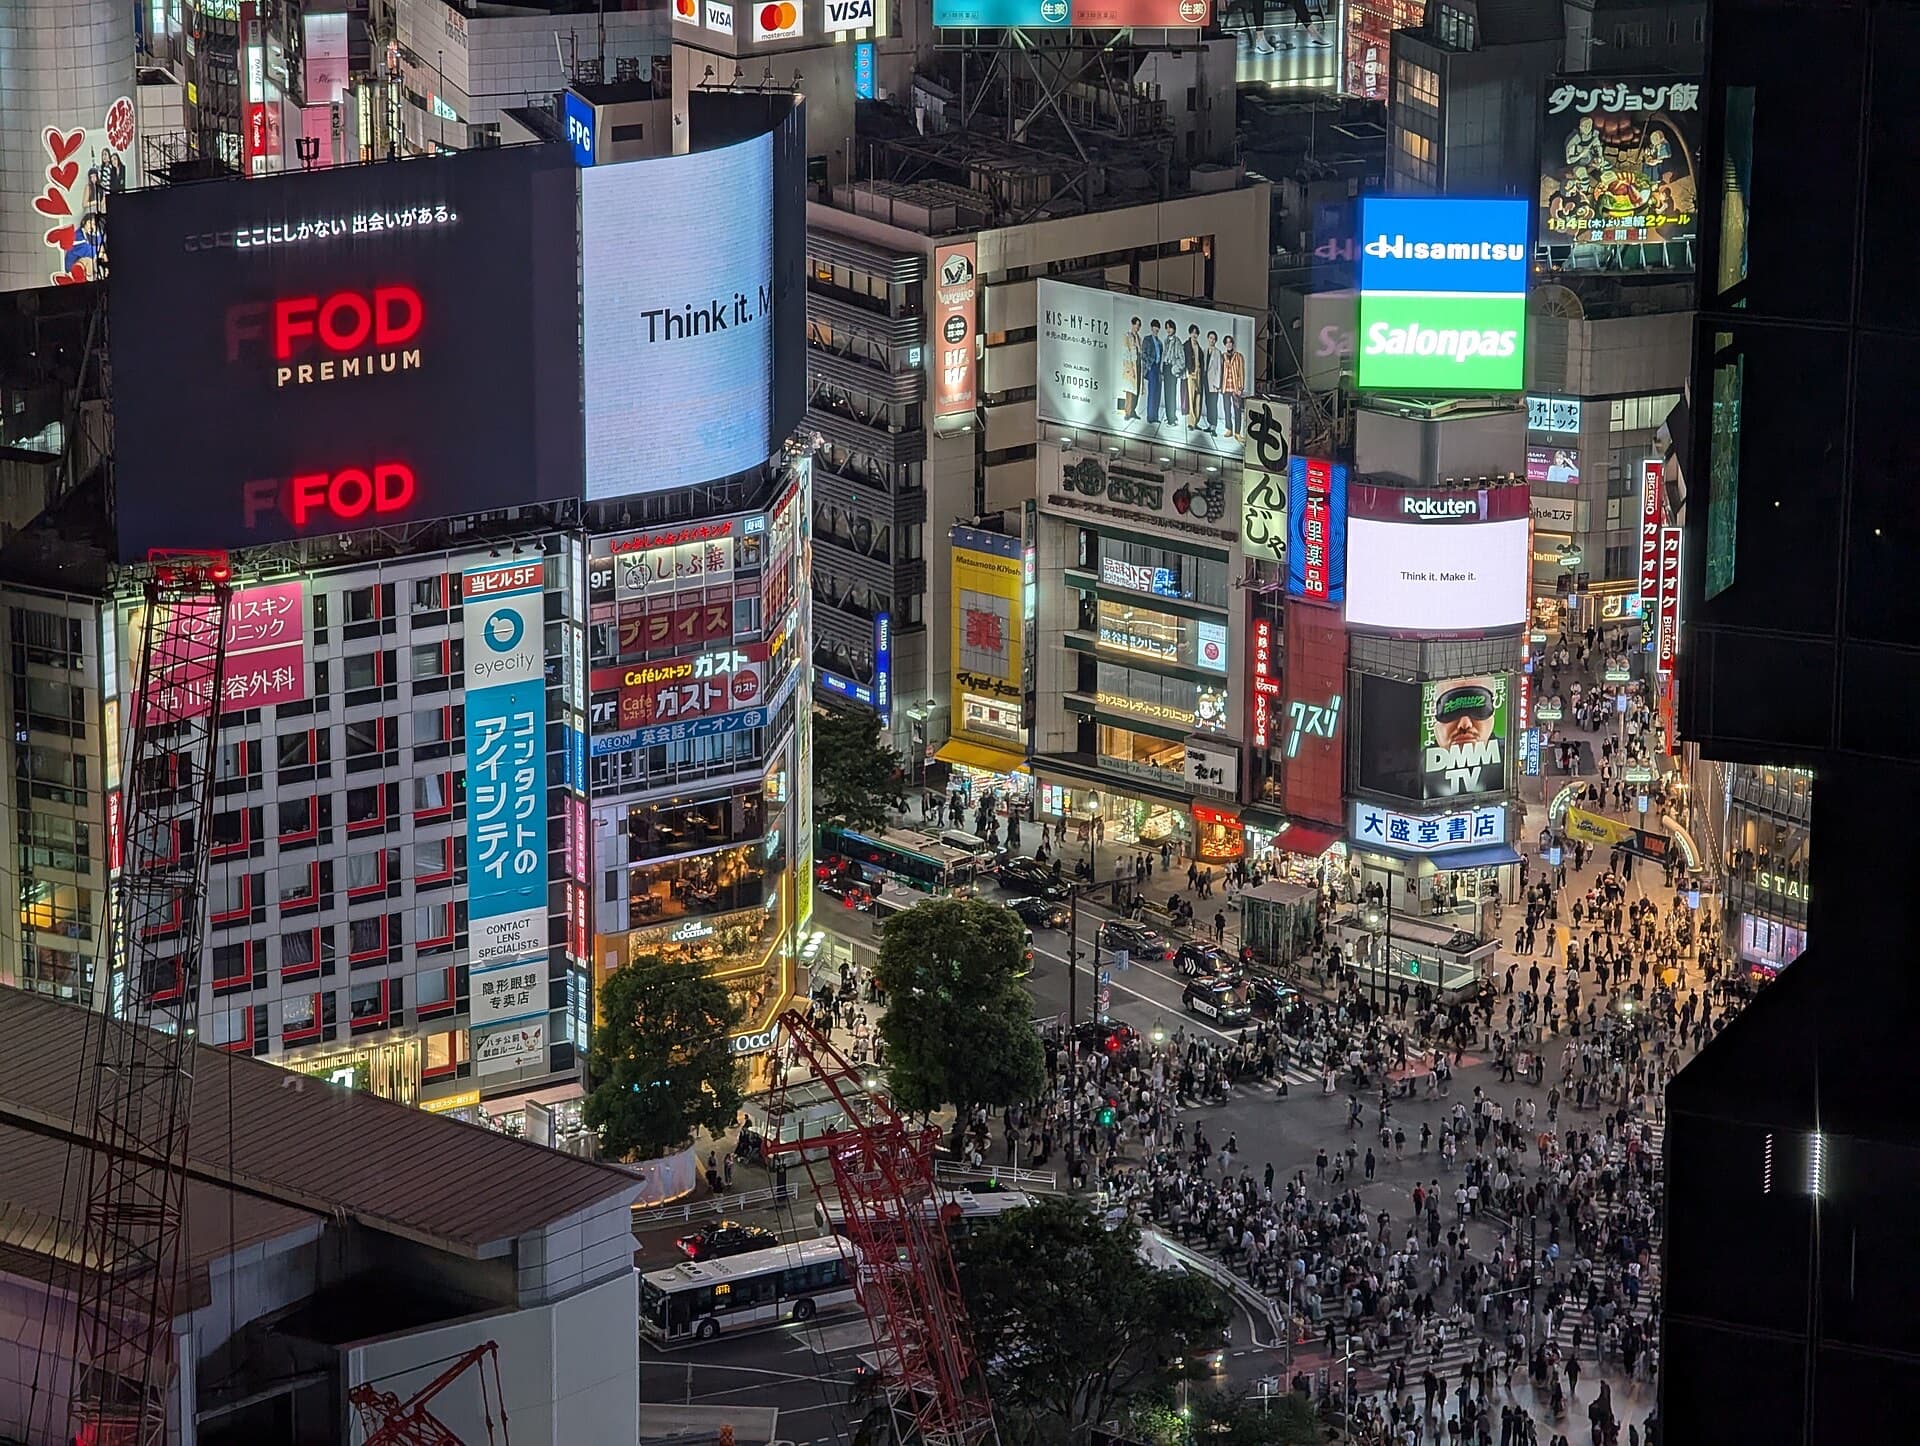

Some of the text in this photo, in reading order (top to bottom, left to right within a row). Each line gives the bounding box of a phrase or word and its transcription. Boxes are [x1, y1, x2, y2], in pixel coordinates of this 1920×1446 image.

[709, 8, 732, 28] VISA
[827, 0, 872, 22] VISA
[761, 30, 796, 41] mastercard
[1549, 83, 1699, 114] ダンジョン飯
[569, 115, 591, 152] FPG
[236, 205, 458, 248] ここにしかない 出会いがある。
[1364, 234, 1524, 261] Hisamitsu
[274, 286, 423, 359] FOD
[640, 299, 728, 343] Think
[734, 292, 753, 326] it.
[1365, 322, 1517, 363] Salonpas
[277, 349, 422, 387] PREMIUM
[1054, 370, 1100, 391] Synopsis
[293, 463, 414, 524] FOD
[1246, 403, 1288, 560] もんじゃ
[1404, 497, 1476, 520] Rakuten
[1305, 469, 1325, 592] 三千里薬品
[657, 547, 725, 580] しゃぶ葉
[1642, 522, 1658, 590] カラオケ
[471, 567, 535, 593] 当ビル5F
[591, 570, 612, 589] 9F
[1400, 571, 1477, 582] Think it. Make it.
[1662, 538, 1679, 608] カラオケ
[619, 607, 729, 648] プライス
[880, 619, 888, 651] MIZUHO
[474, 652, 535, 678] eyecity
[694, 650, 748, 679] ガスト
[622, 694, 653, 712] Café
[656, 682, 722, 719] ガスト
[734, 683, 756, 694] ガスト
[1492, 678, 1506, 709] 再び
[591, 701, 617, 722] 7F
[745, 713, 761, 726] 6F
[1424, 685, 1437, 747] 脱出せよ
[642, 716, 739, 745] 英会話イーオン
[1287, 695, 1342, 758] クスリ
[599, 735, 632, 750] AEON
[1425, 738, 1501, 773] DMM
[513, 710, 538, 875] コンタクトの
[1445, 766, 1482, 795] TV
[474, 716, 510, 880] アイシティ
[1364, 812, 1496, 844] 大盛堂書店
[486, 918, 532, 936] CONTACT
[496, 931, 521, 945] LENS
[478, 938, 540, 959] SPECIALISTS
[482, 973, 537, 997] 隐形眼镜
[489, 991, 531, 1010] 专卖店
[483, 1043, 524, 1058] 献血ルーム
